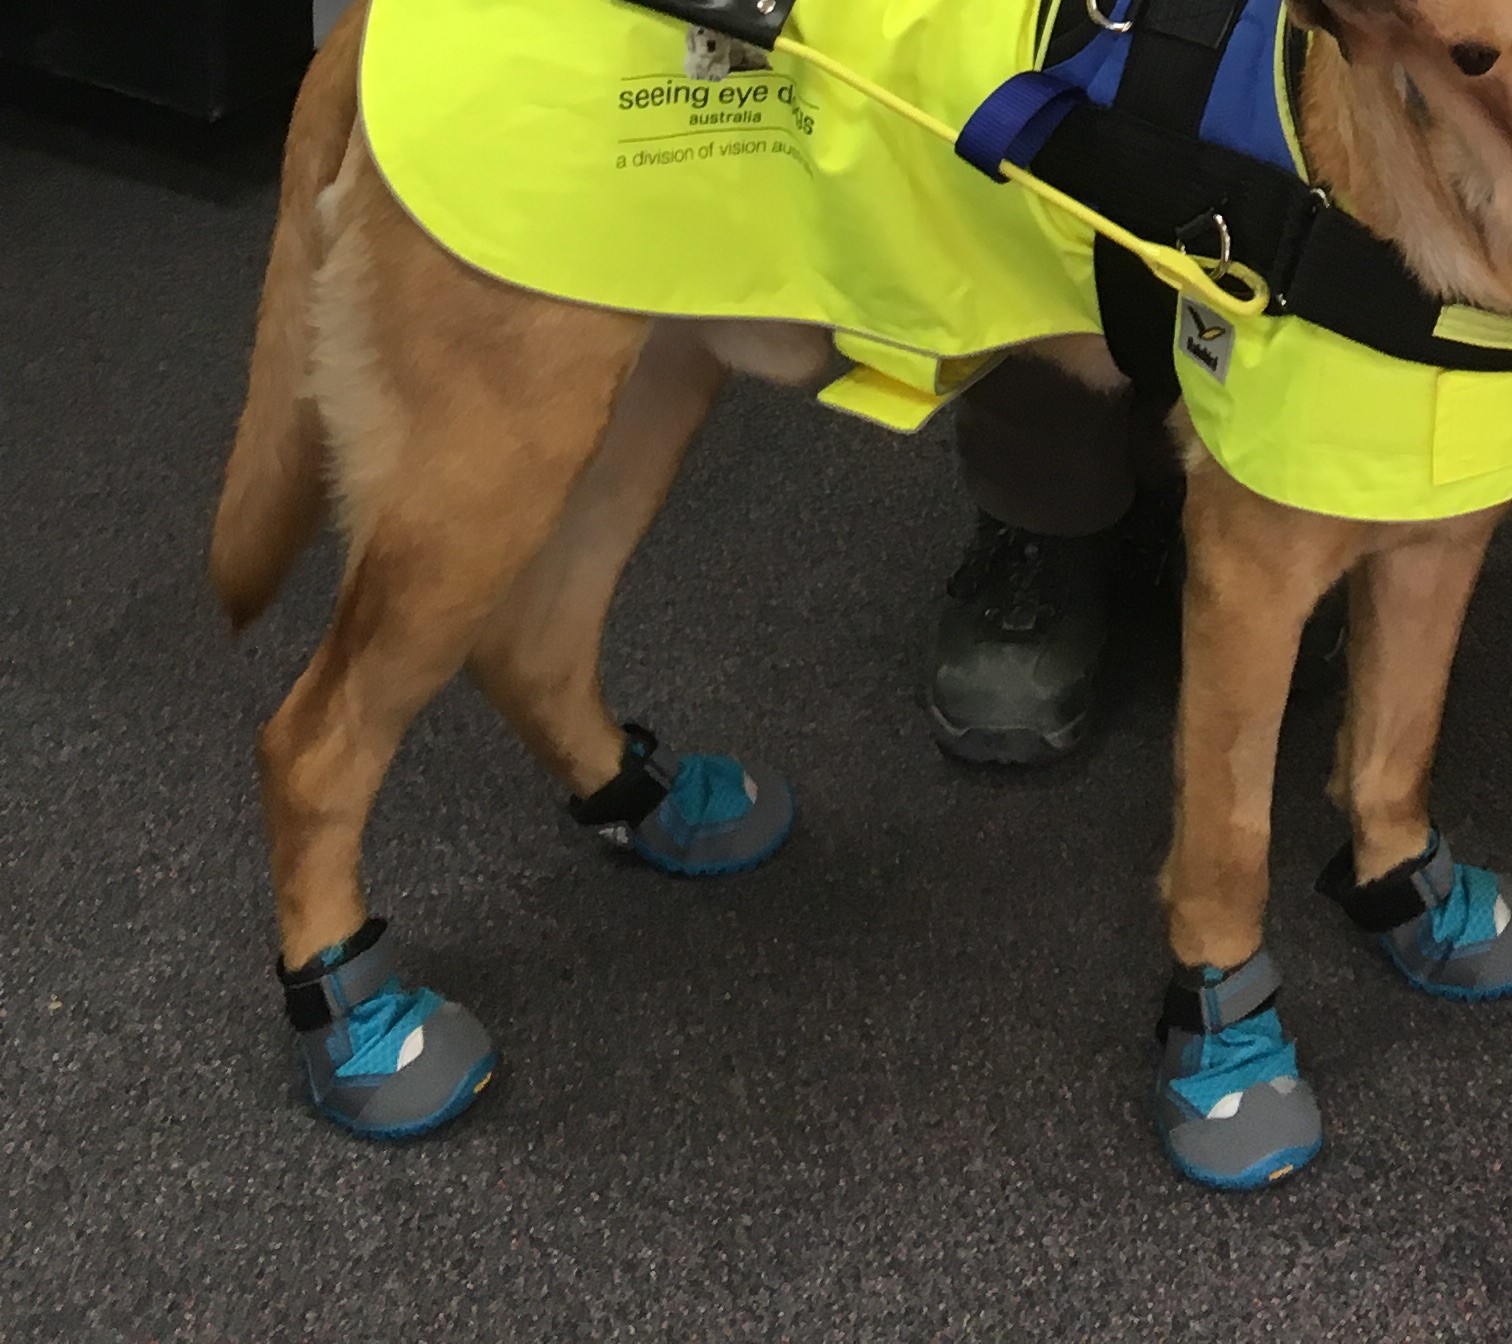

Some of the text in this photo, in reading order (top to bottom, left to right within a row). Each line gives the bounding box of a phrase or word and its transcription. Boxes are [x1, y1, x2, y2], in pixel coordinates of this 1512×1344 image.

[618, 80, 710, 110] seeing
[718, 84, 769, 109] eye
[688, 110, 762, 127] australia
[615, 139, 767, 170] a division of vision
